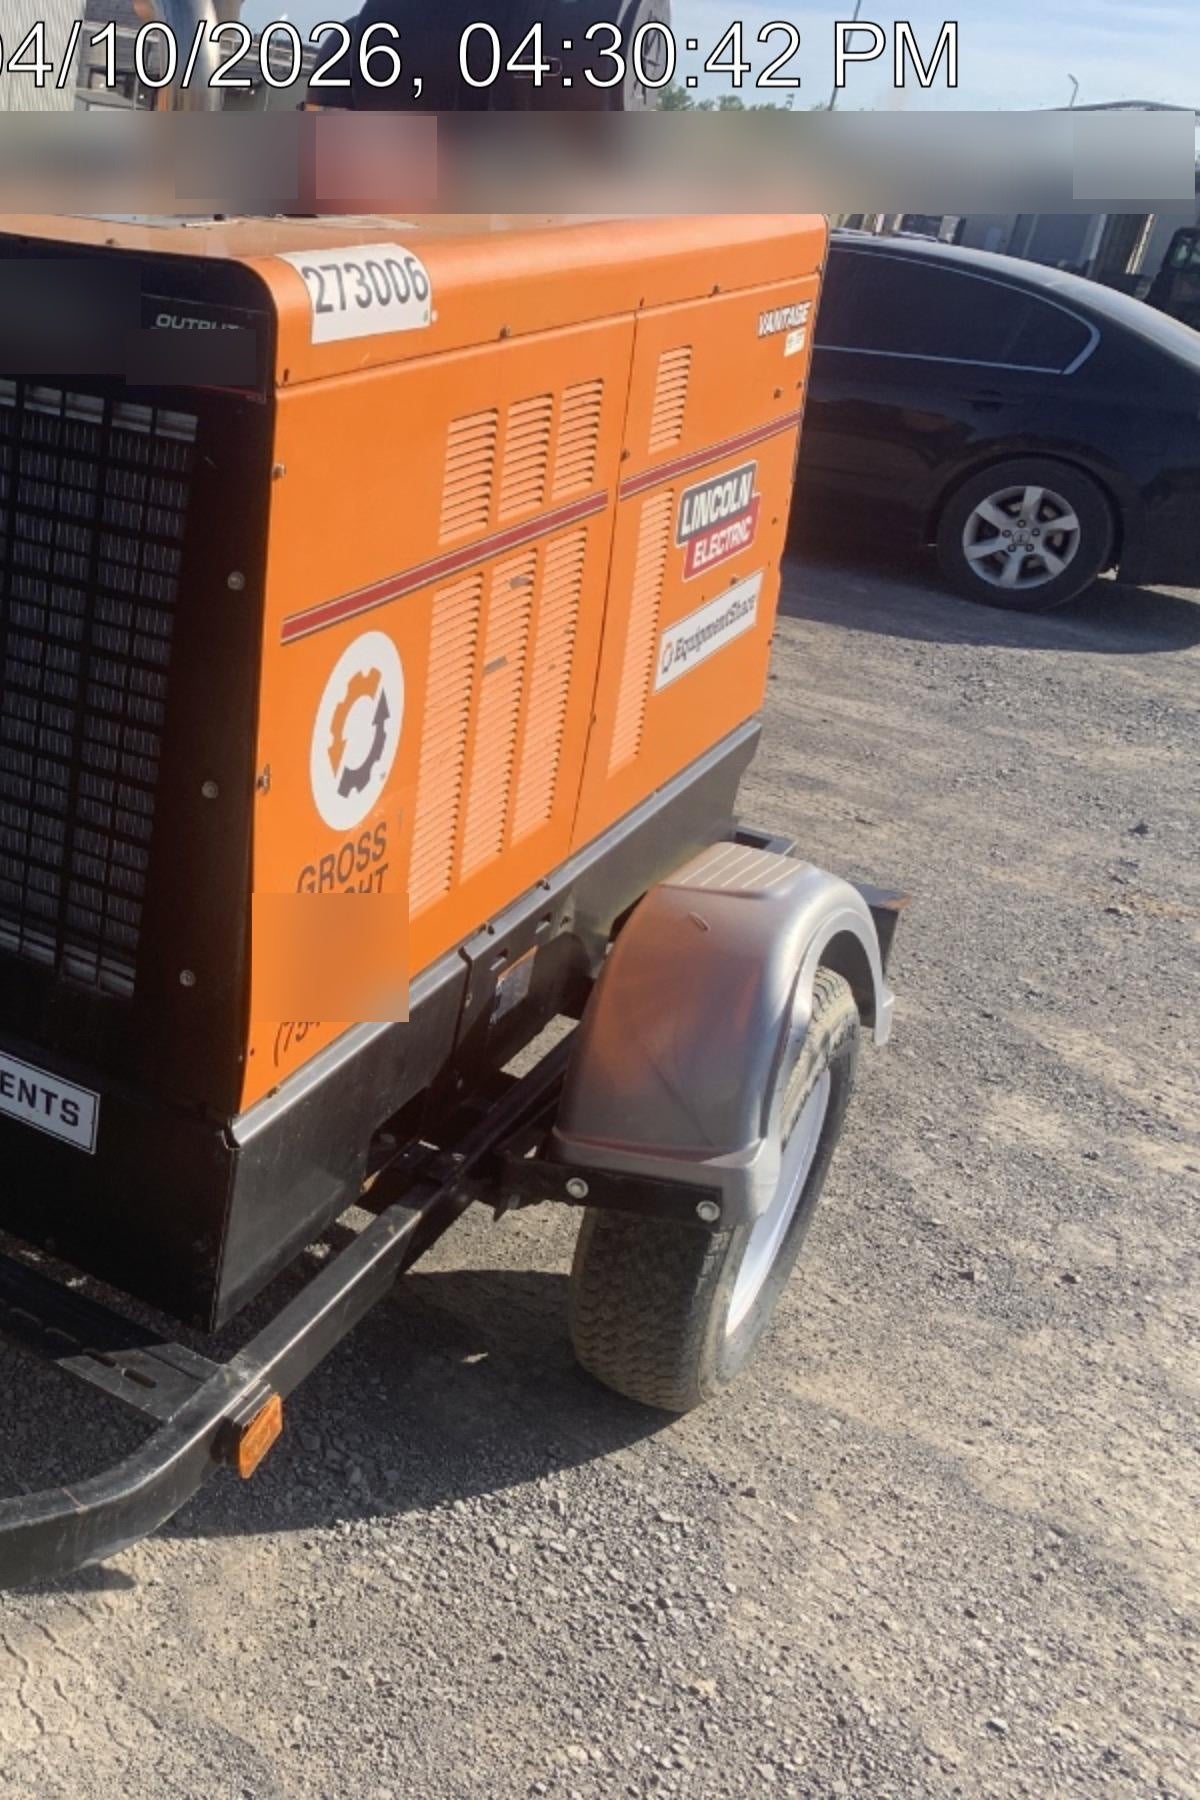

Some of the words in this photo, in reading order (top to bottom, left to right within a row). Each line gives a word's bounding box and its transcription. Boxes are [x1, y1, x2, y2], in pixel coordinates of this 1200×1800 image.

[301, 256, 429, 314] 273006
[680, 471, 754, 536] LINCOLN
[692, 515, 753, 569] ELECTRIC
[297, 822, 387, 893] GROSS
